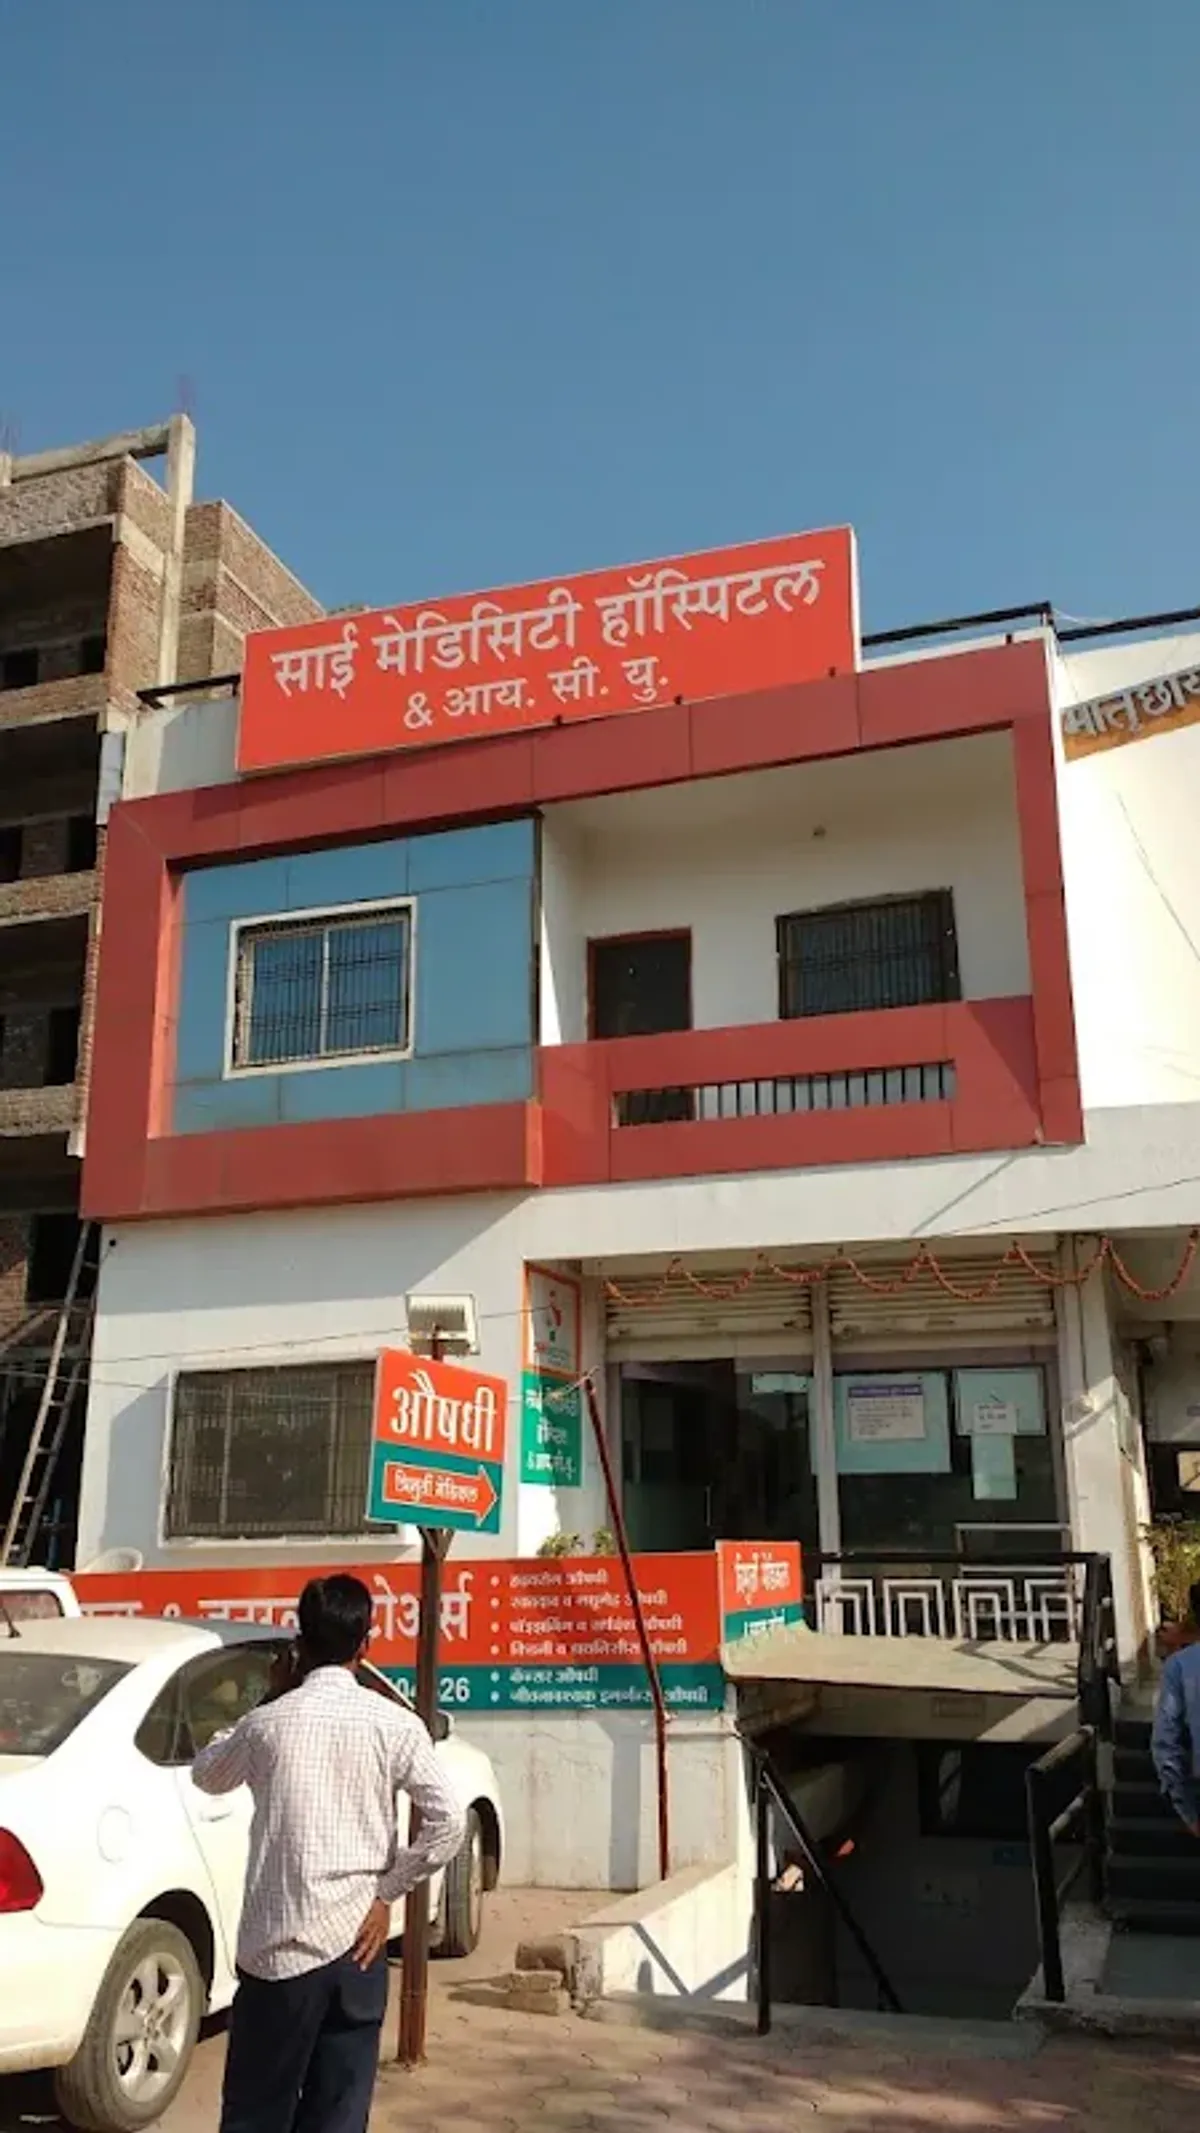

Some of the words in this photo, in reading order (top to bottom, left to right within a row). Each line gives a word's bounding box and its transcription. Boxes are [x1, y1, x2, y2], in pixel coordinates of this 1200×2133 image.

[270, 620, 359, 701] साई
[373, 587, 581, 677] मेडिसिटी
[595, 558, 825, 650] हॉस्पिटल
[404, 693, 433, 730] &
[445, 677, 535, 720] आय.
[549, 658, 610, 706] सी.
[621, 655, 669, 703] यु.
[389, 1368, 497, 1453] औषधी
[435, 1474, 480, 1503] मेडिकल
[367, 1572, 473, 1642] टोअर्स
[565, 1568, 608, 1586] औषधी
[555, 1666, 599, 1683] औषधी
